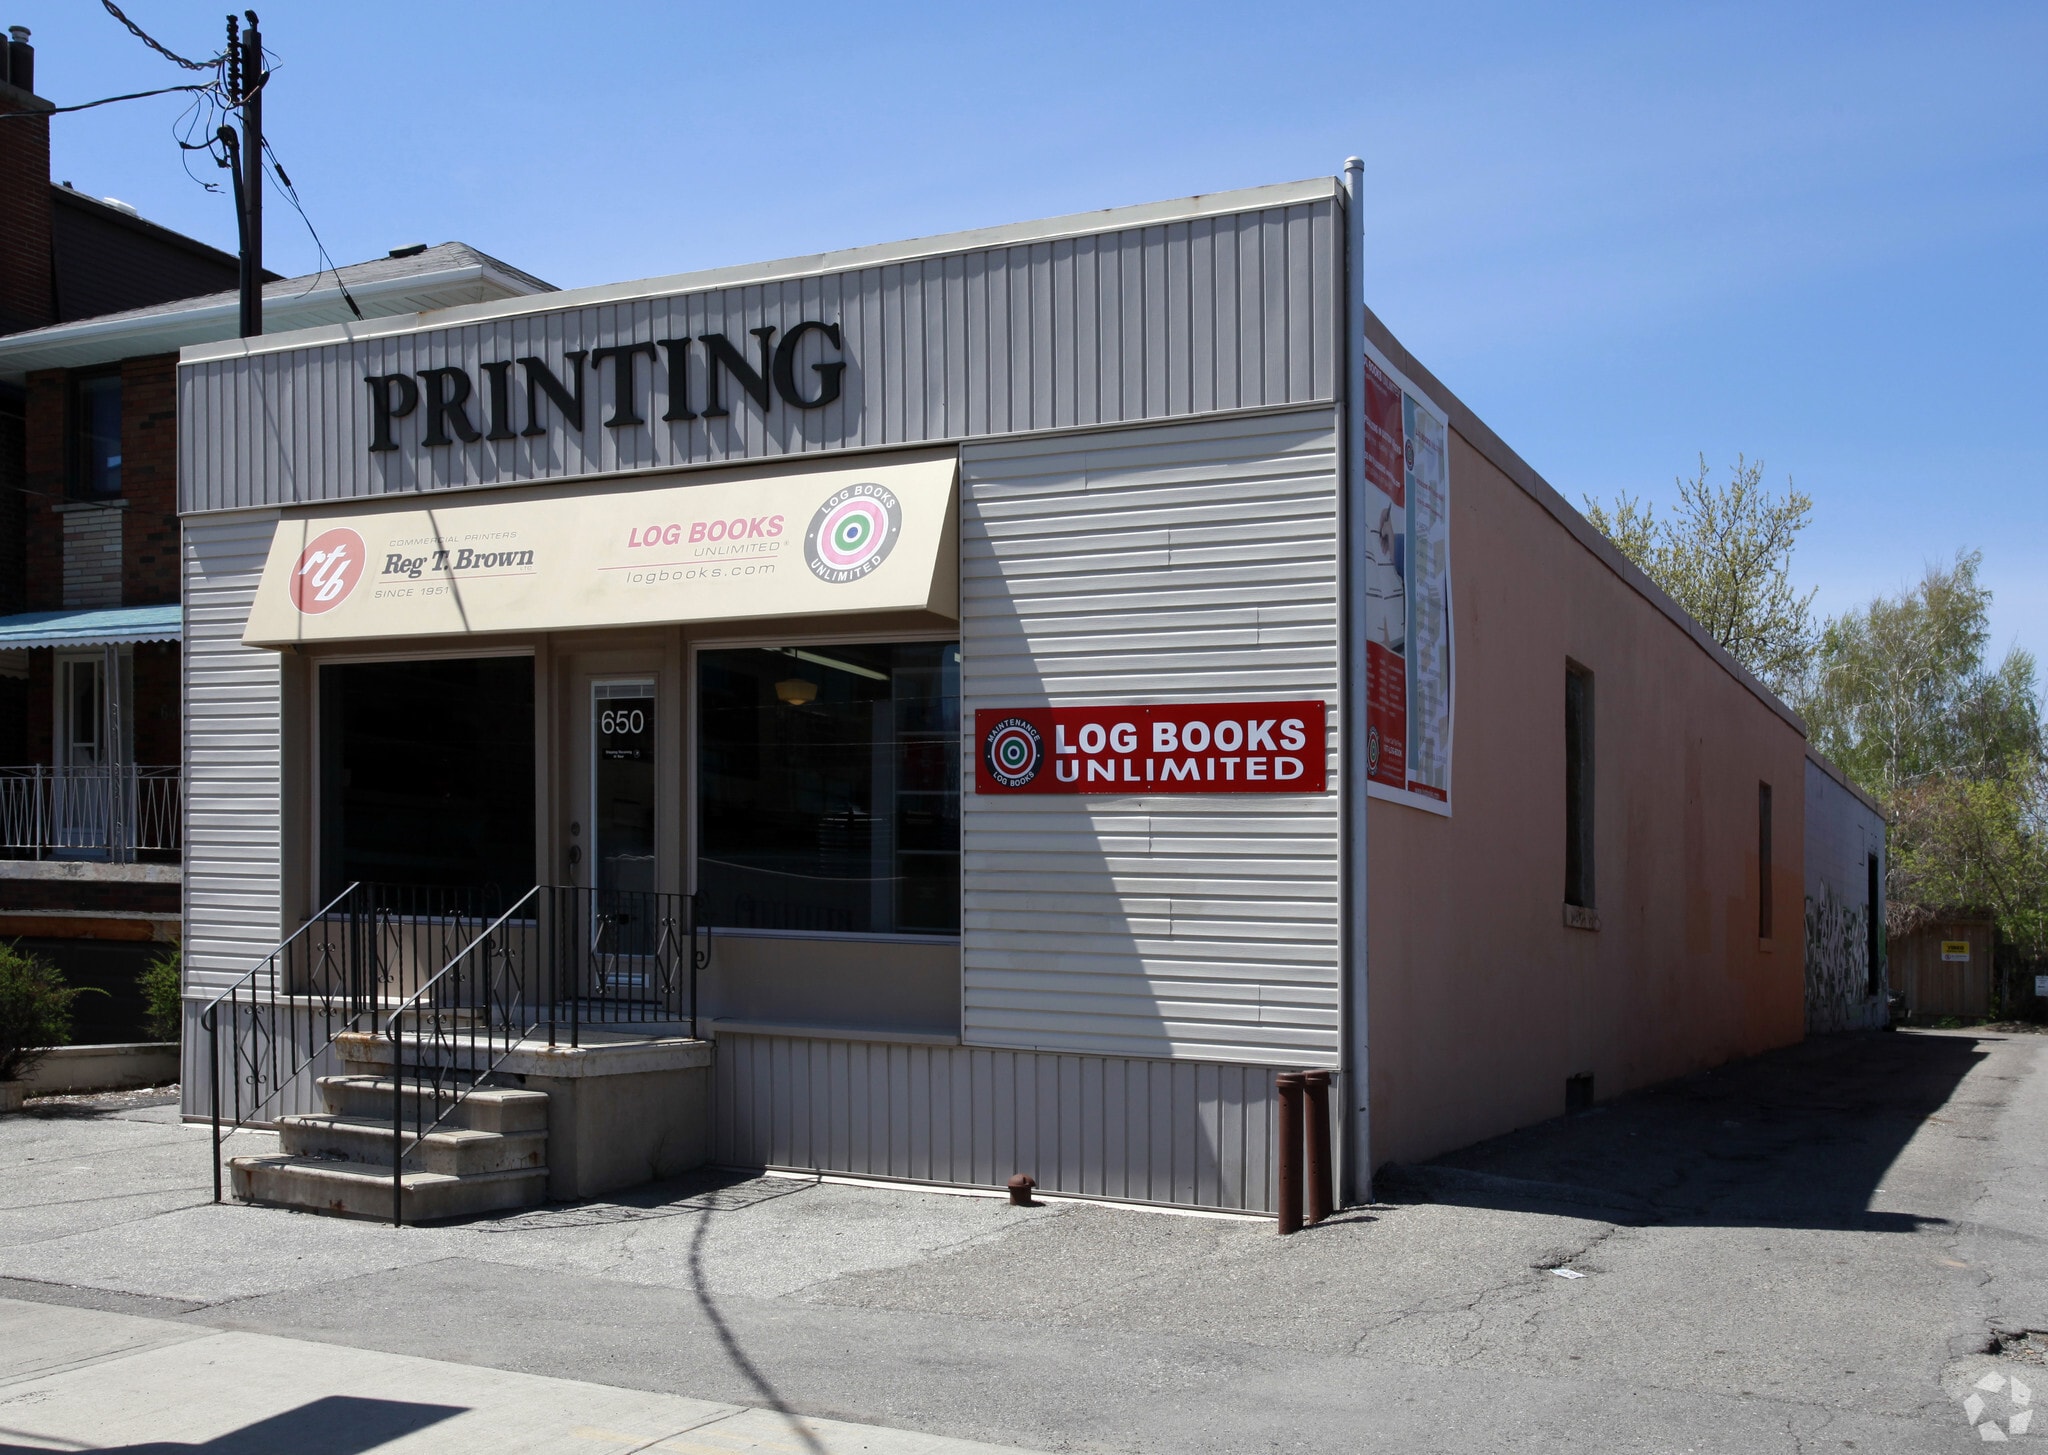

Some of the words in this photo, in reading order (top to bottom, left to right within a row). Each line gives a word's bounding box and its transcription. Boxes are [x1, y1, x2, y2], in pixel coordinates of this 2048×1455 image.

[363, 320, 846, 452] PRINTING
[821, 490, 849, 514] LOG
[854, 485, 896, 509] BOOKS
[389, 536, 459, 548] COMMERCIAL
[464, 531, 518, 543] PRINTERS
[628, 523, 682, 548] LOG
[688, 514, 785, 543] BOOKS
[694, 541, 780, 557] UNLIMITED
[381, 553, 427, 579] Reg
[432, 549, 450, 571] T.
[453, 548, 534, 571] Brown
[626, 564, 776, 585] logbooks.com
[811, 555, 881, 582] UNLIMITED
[374, 588, 414, 599] SINCE
[420, 586, 450, 597] 1951
[601, 709, 644, 734] 650
[987, 718, 1041, 743] MAINTENANCE
[1055, 722, 1137, 754] LOG
[1151, 718, 1306, 753] BOOKS
[993, 771, 1008, 785] LOG
[1010, 771, 1035, 787] BOOKS
[1055, 756, 1304, 783] UNLIMITED
